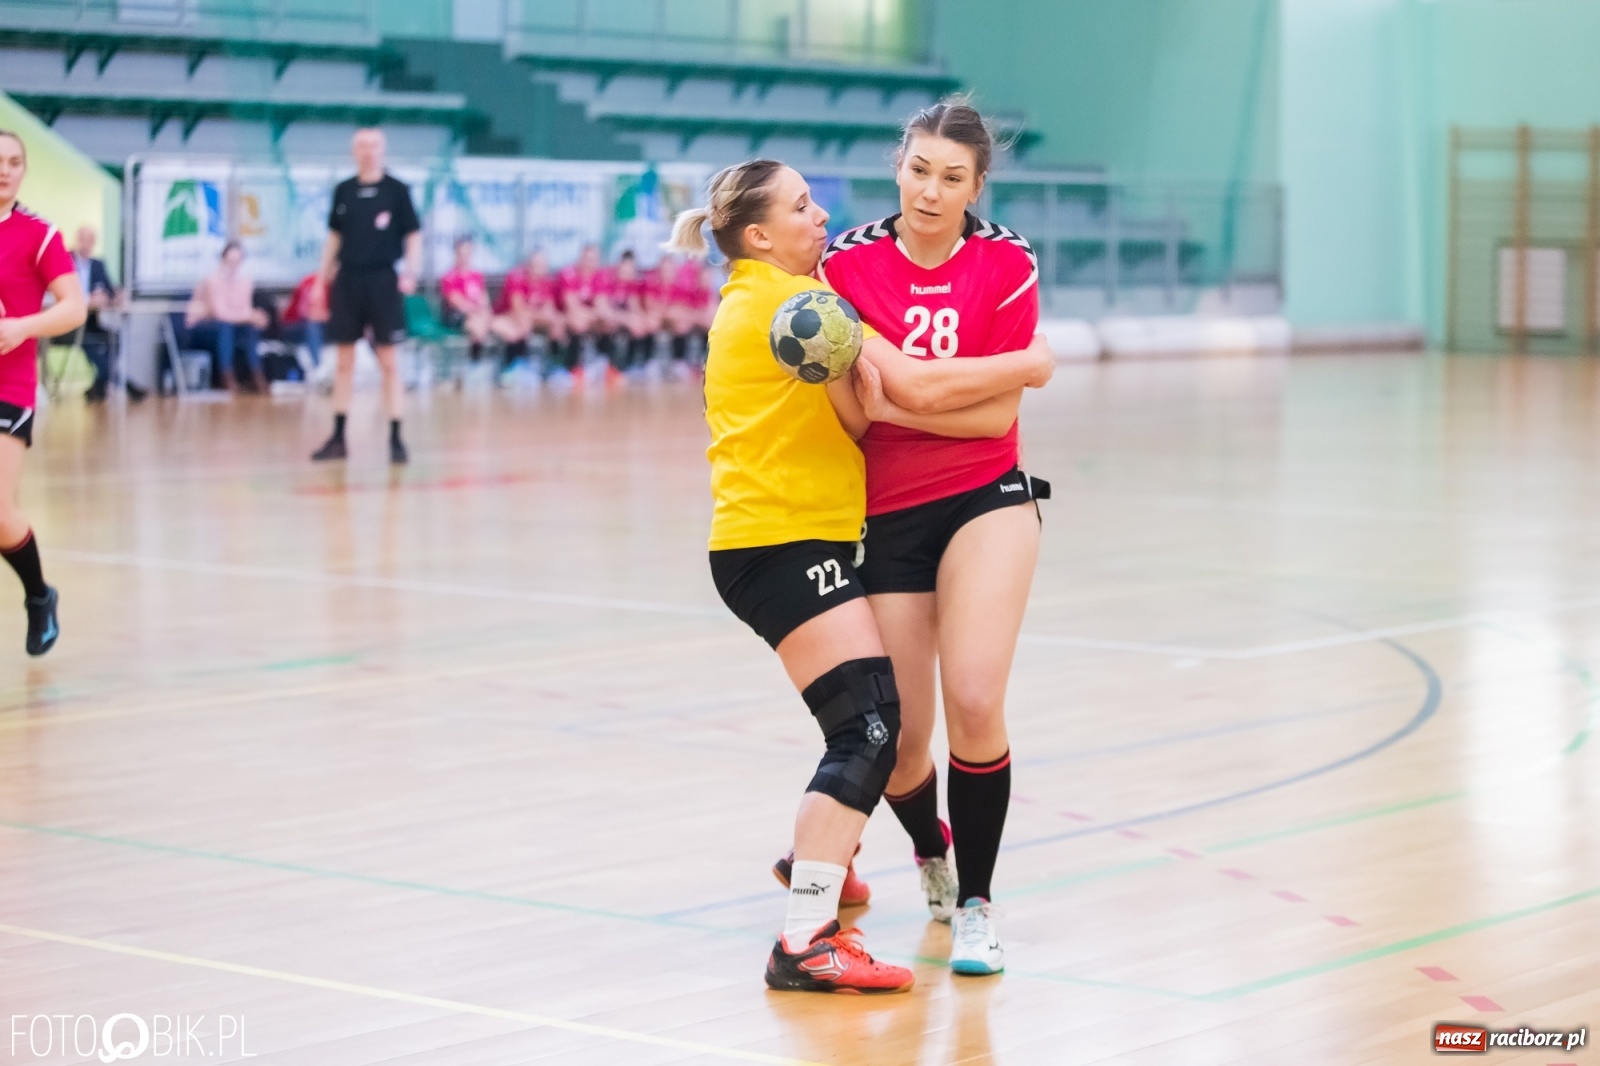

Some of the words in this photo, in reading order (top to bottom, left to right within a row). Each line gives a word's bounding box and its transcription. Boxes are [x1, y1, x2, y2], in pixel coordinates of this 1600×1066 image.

[910, 281, 951, 295] hummel
[902, 305, 959, 359] 28
[806, 558, 850, 597] 22
